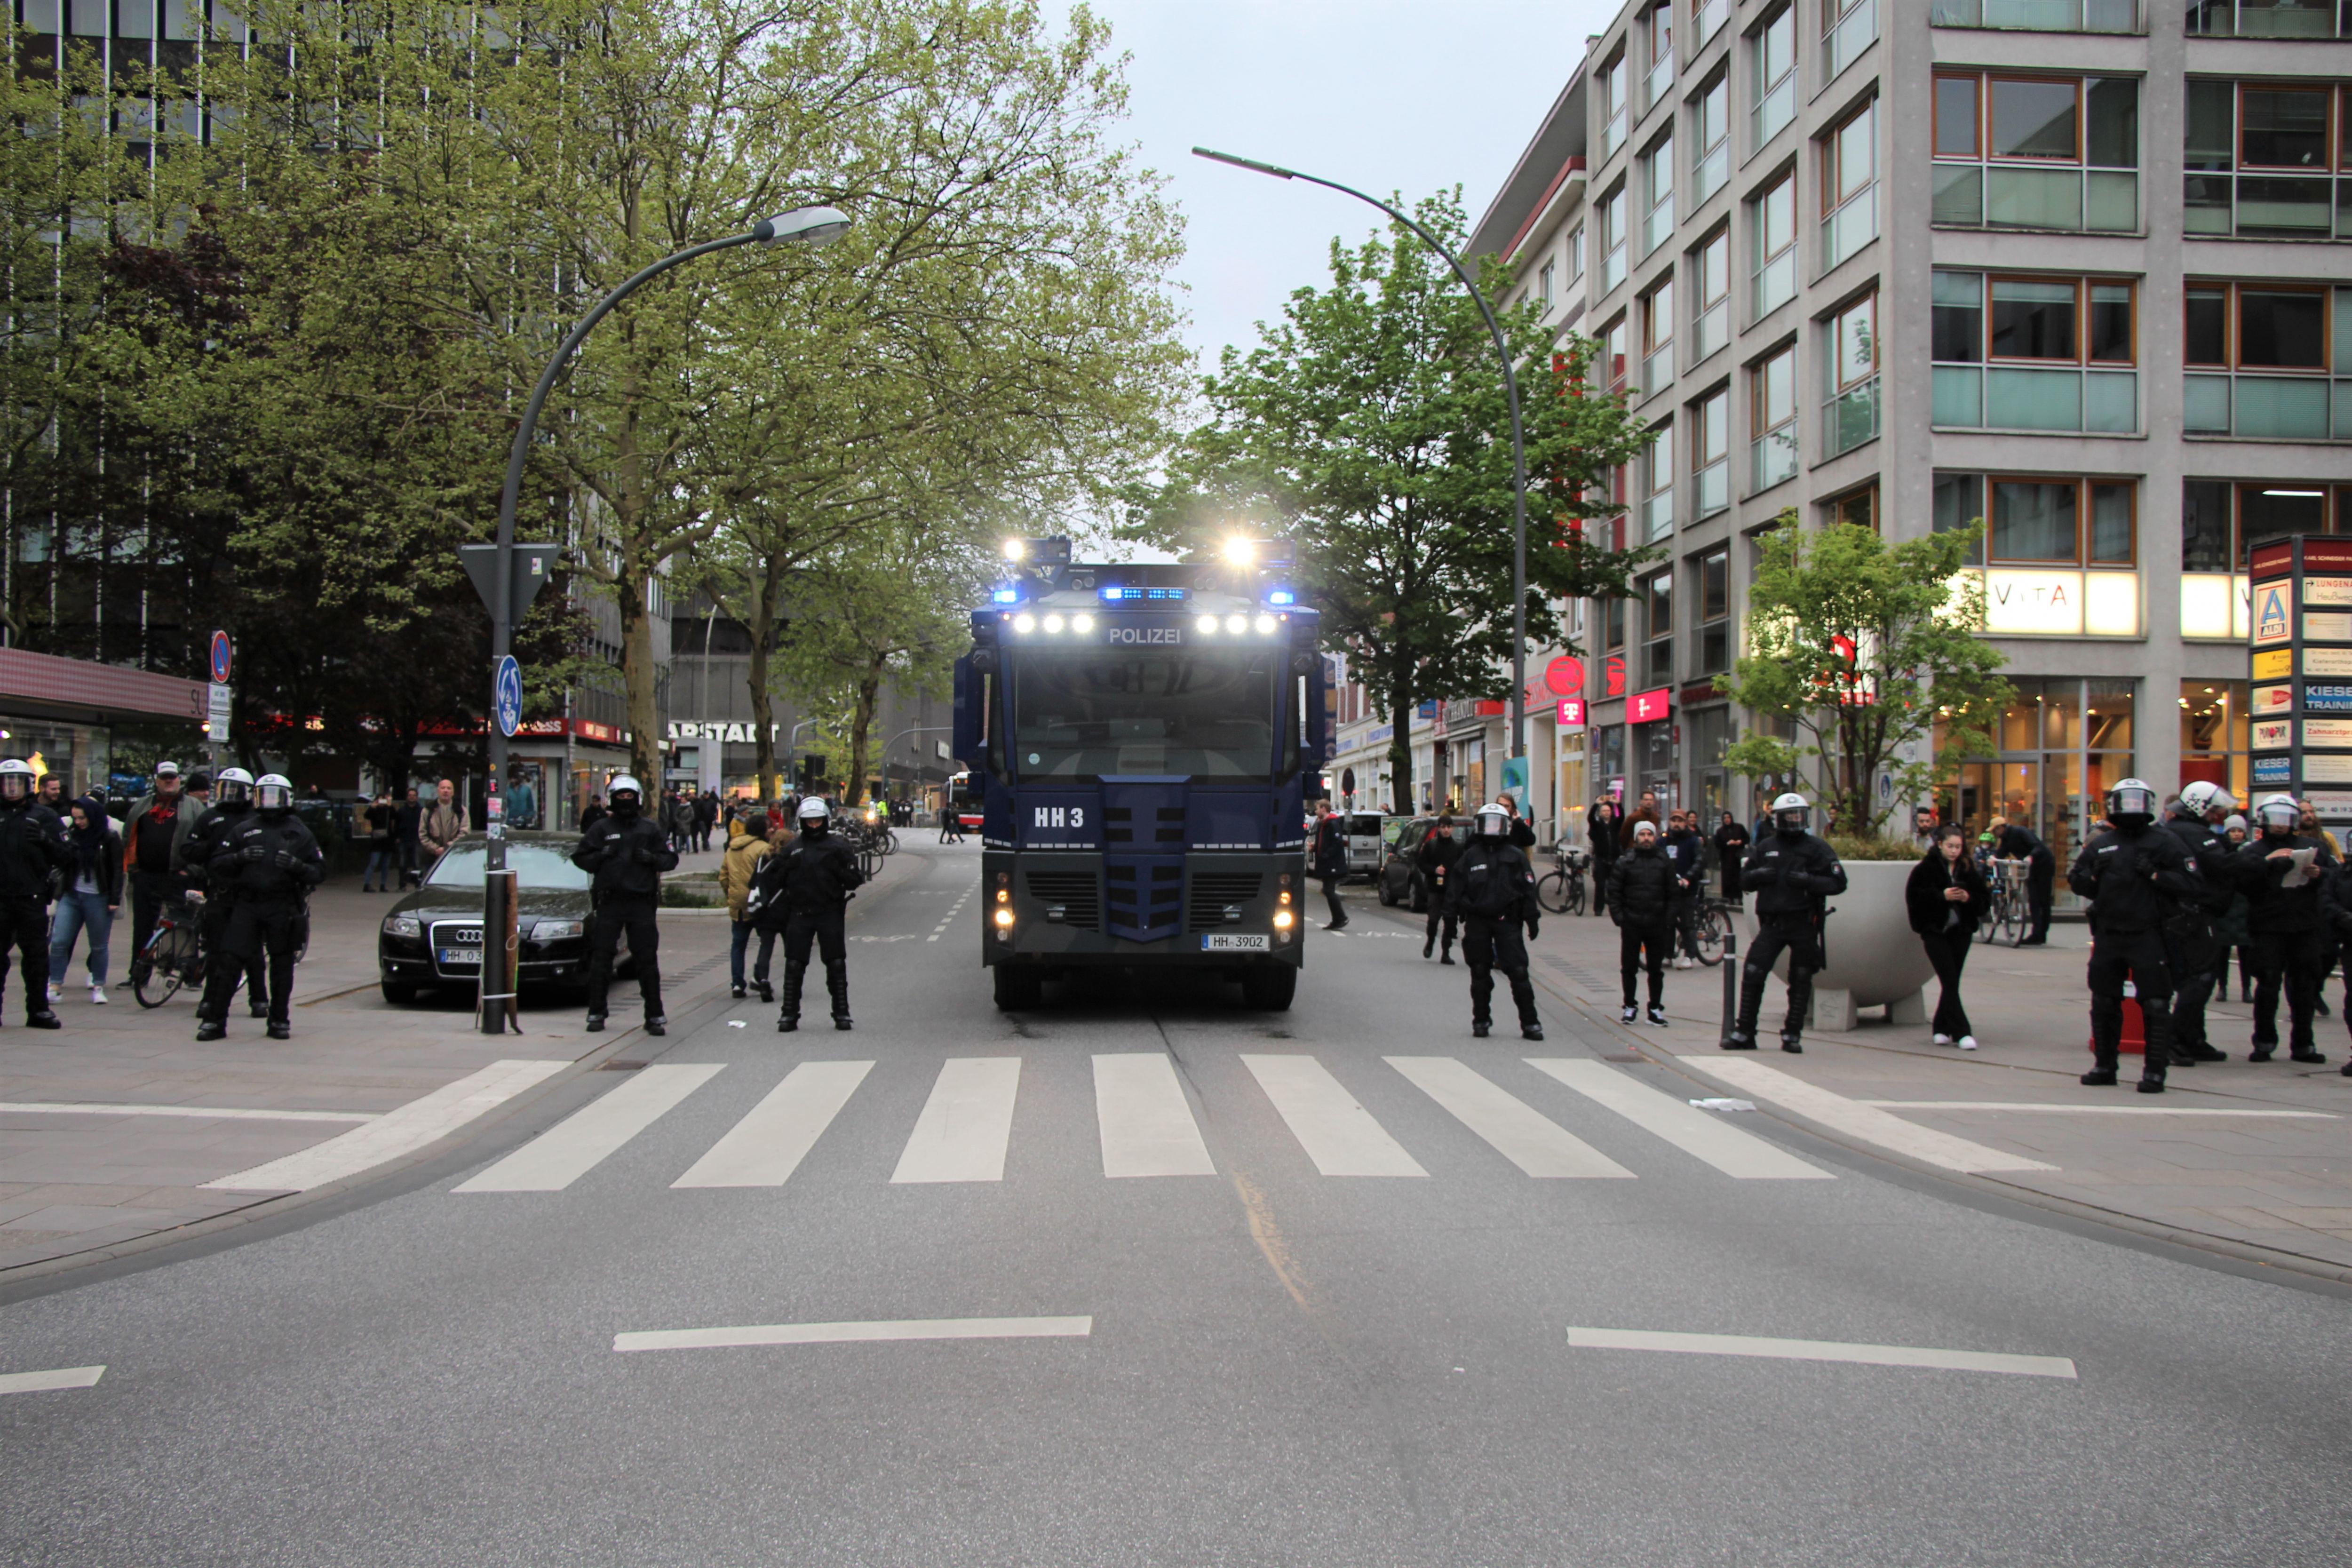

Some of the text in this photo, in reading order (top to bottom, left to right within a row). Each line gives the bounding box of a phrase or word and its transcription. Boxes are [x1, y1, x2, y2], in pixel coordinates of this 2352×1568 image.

[2261, 623, 2285, 637] ALDI
[1109, 628, 1181, 644] POLIZEI
[2305, 700, 2352, 709] TRAINI
[2307, 728, 2352, 736] Zahnarztpr
[2254, 758, 2290, 769] KIESER
[2254, 772, 2290, 782] TRAINING
[1035, 807, 1083, 828] HH 3
[243, 828, 262, 838] POLIZEI
[1214, 936, 1263, 947] HH 3902
[446, 950, 460, 961] HH
